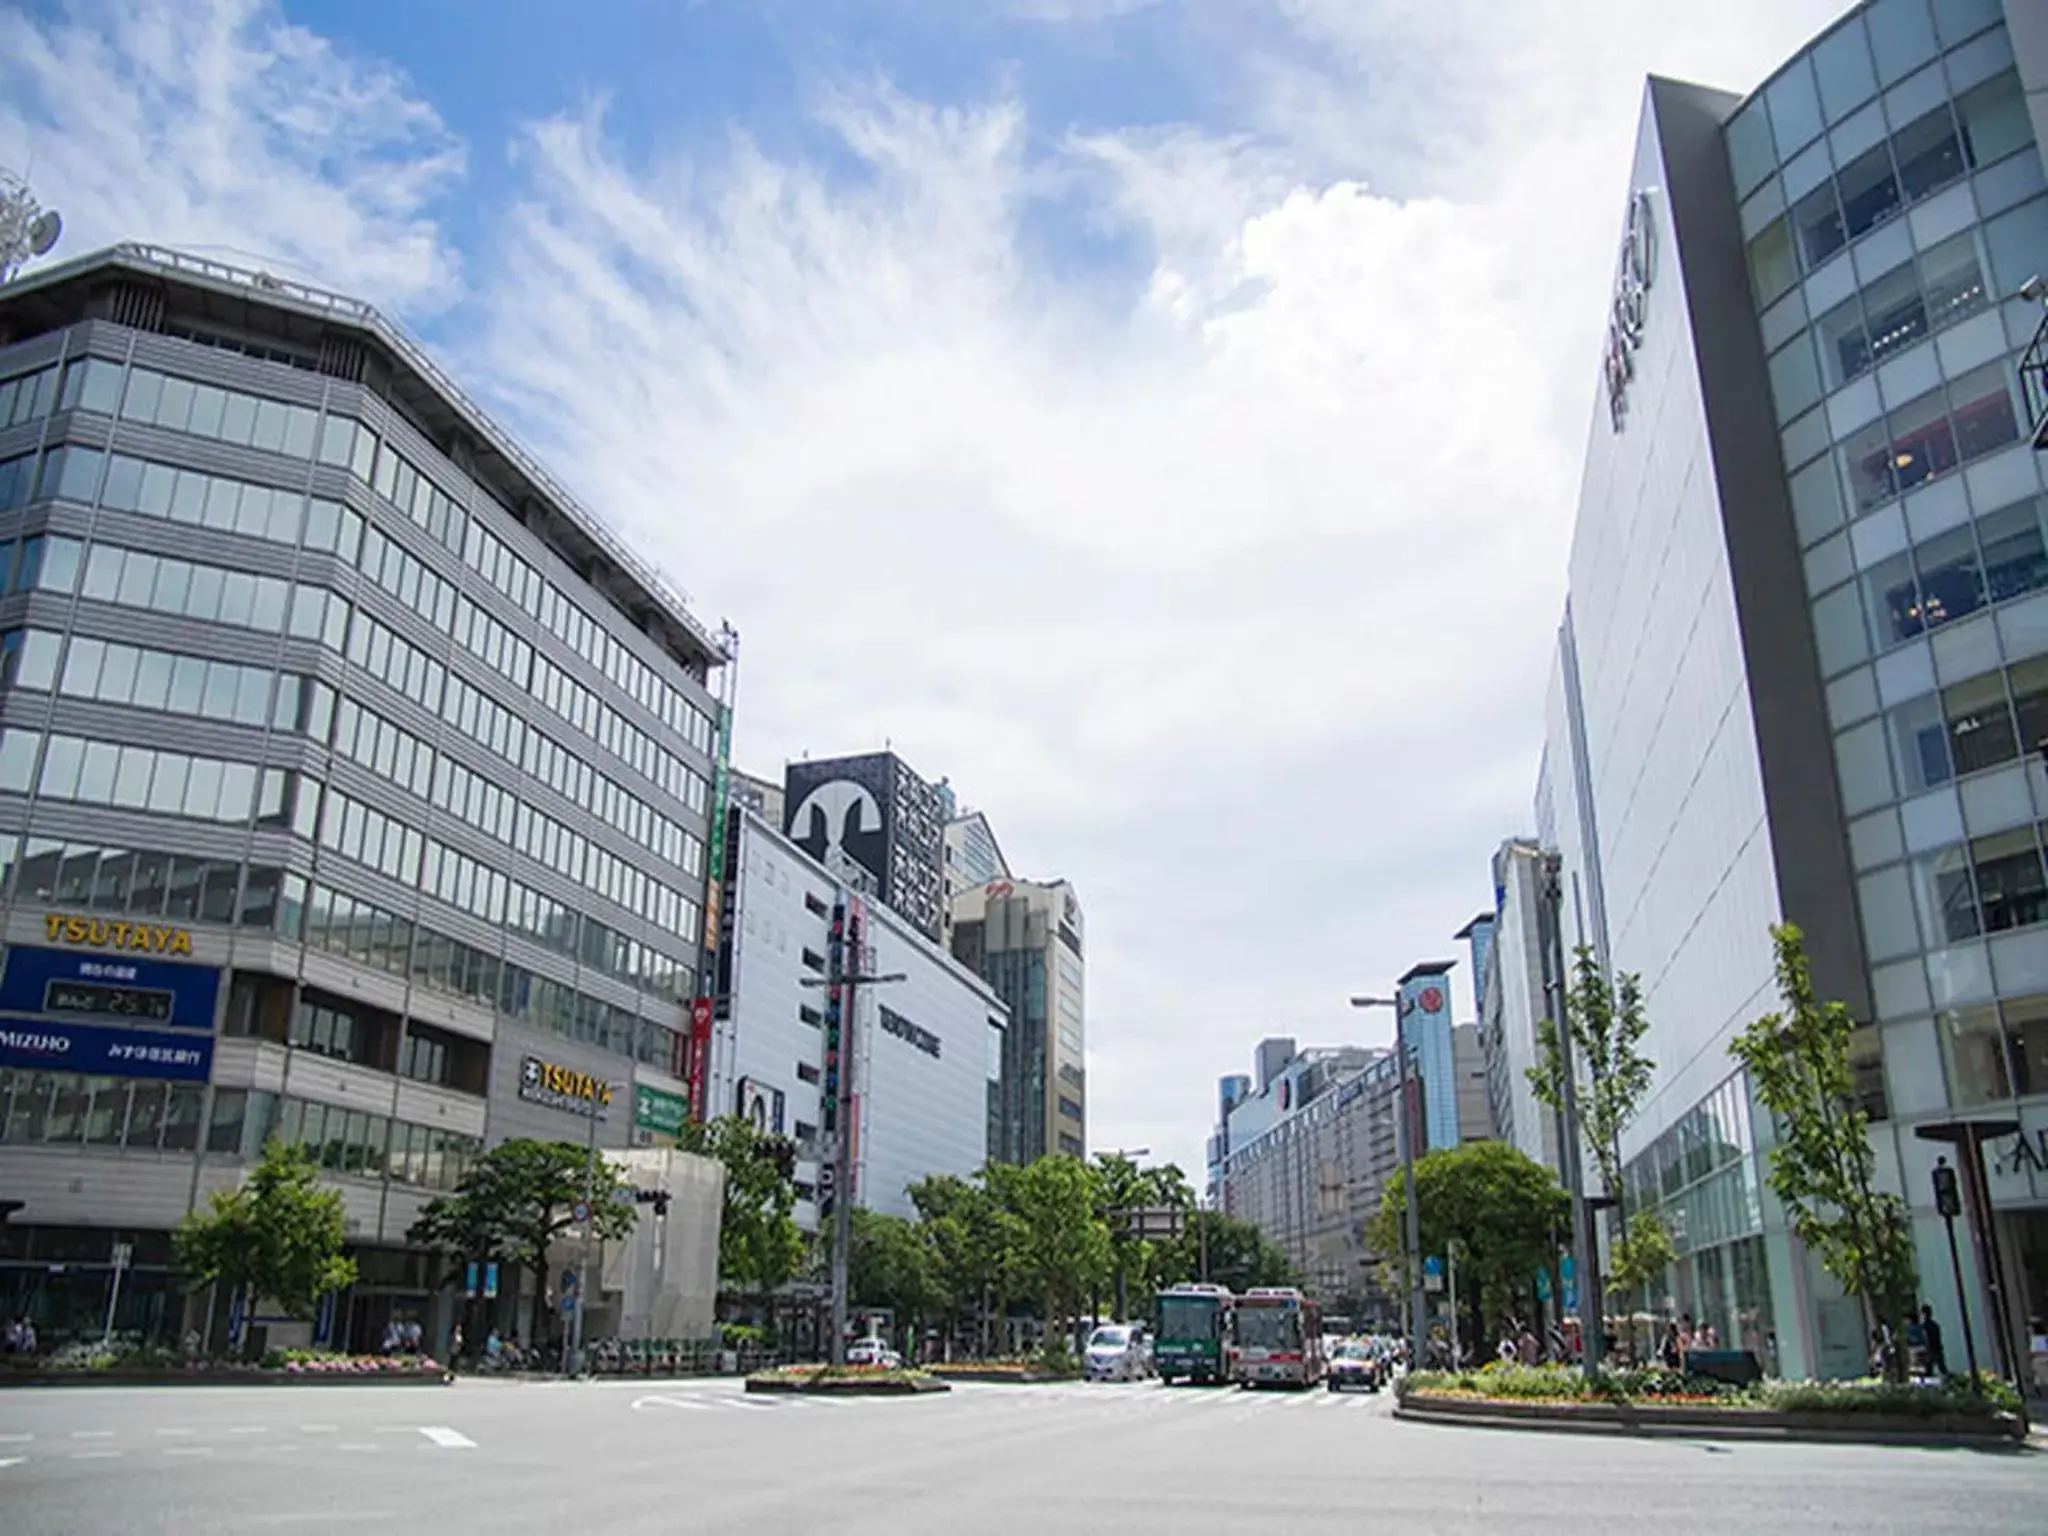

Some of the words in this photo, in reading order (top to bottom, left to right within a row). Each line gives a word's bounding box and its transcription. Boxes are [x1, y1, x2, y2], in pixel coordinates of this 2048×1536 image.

[45, 912, 192, 956] TSUTAYA
[0, 1030, 71, 1052] MIZUHO
[541, 1063, 613, 1107] TSUTAYA
